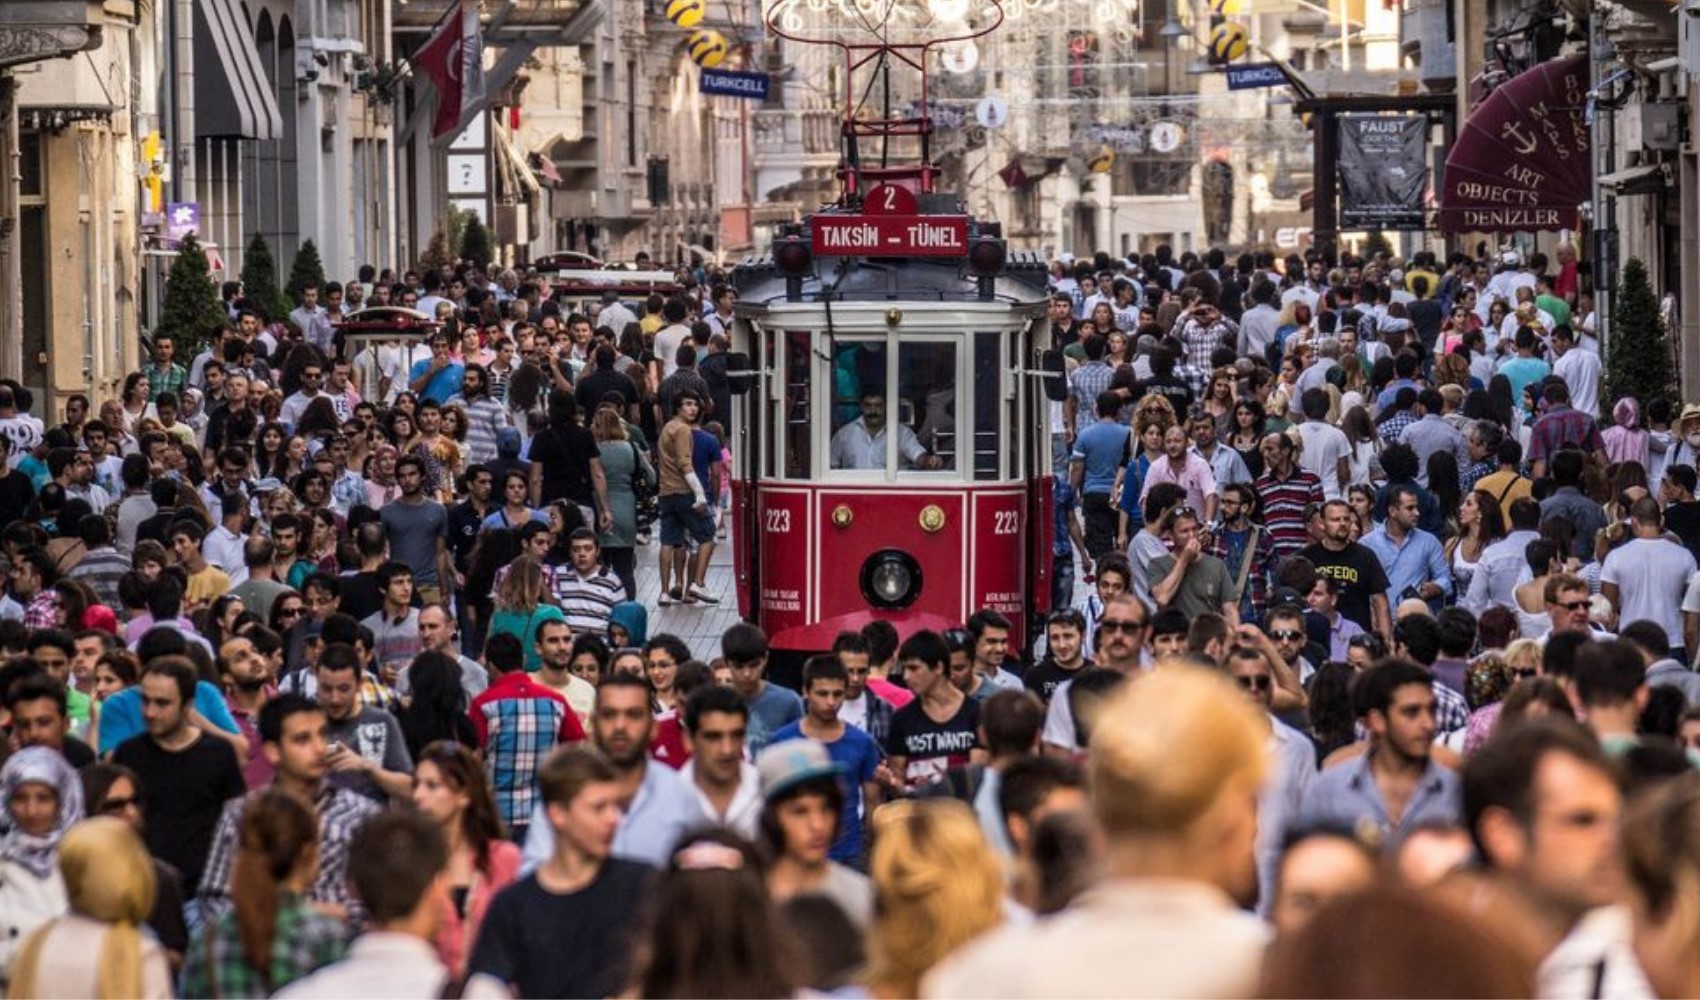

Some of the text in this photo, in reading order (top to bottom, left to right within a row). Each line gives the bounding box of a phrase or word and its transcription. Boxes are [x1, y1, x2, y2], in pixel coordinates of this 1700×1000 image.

[703, 73, 765, 92] TURKCELL
[1564, 74, 1588, 151] BOOKS
[1361, 121, 1405, 133] FAUST
[1529, 101, 1569, 159] MAPS
[1504, 163, 1545, 189] ART
[884, 186, 896, 210] 2
[1456, 181, 1540, 206] OBJECTS
[1464, 206, 1561, 226] DENİZLER
[907, 223, 962, 247] TÜNEL
[766, 509, 791, 533] 223
[994, 510, 1019, 535] 223
